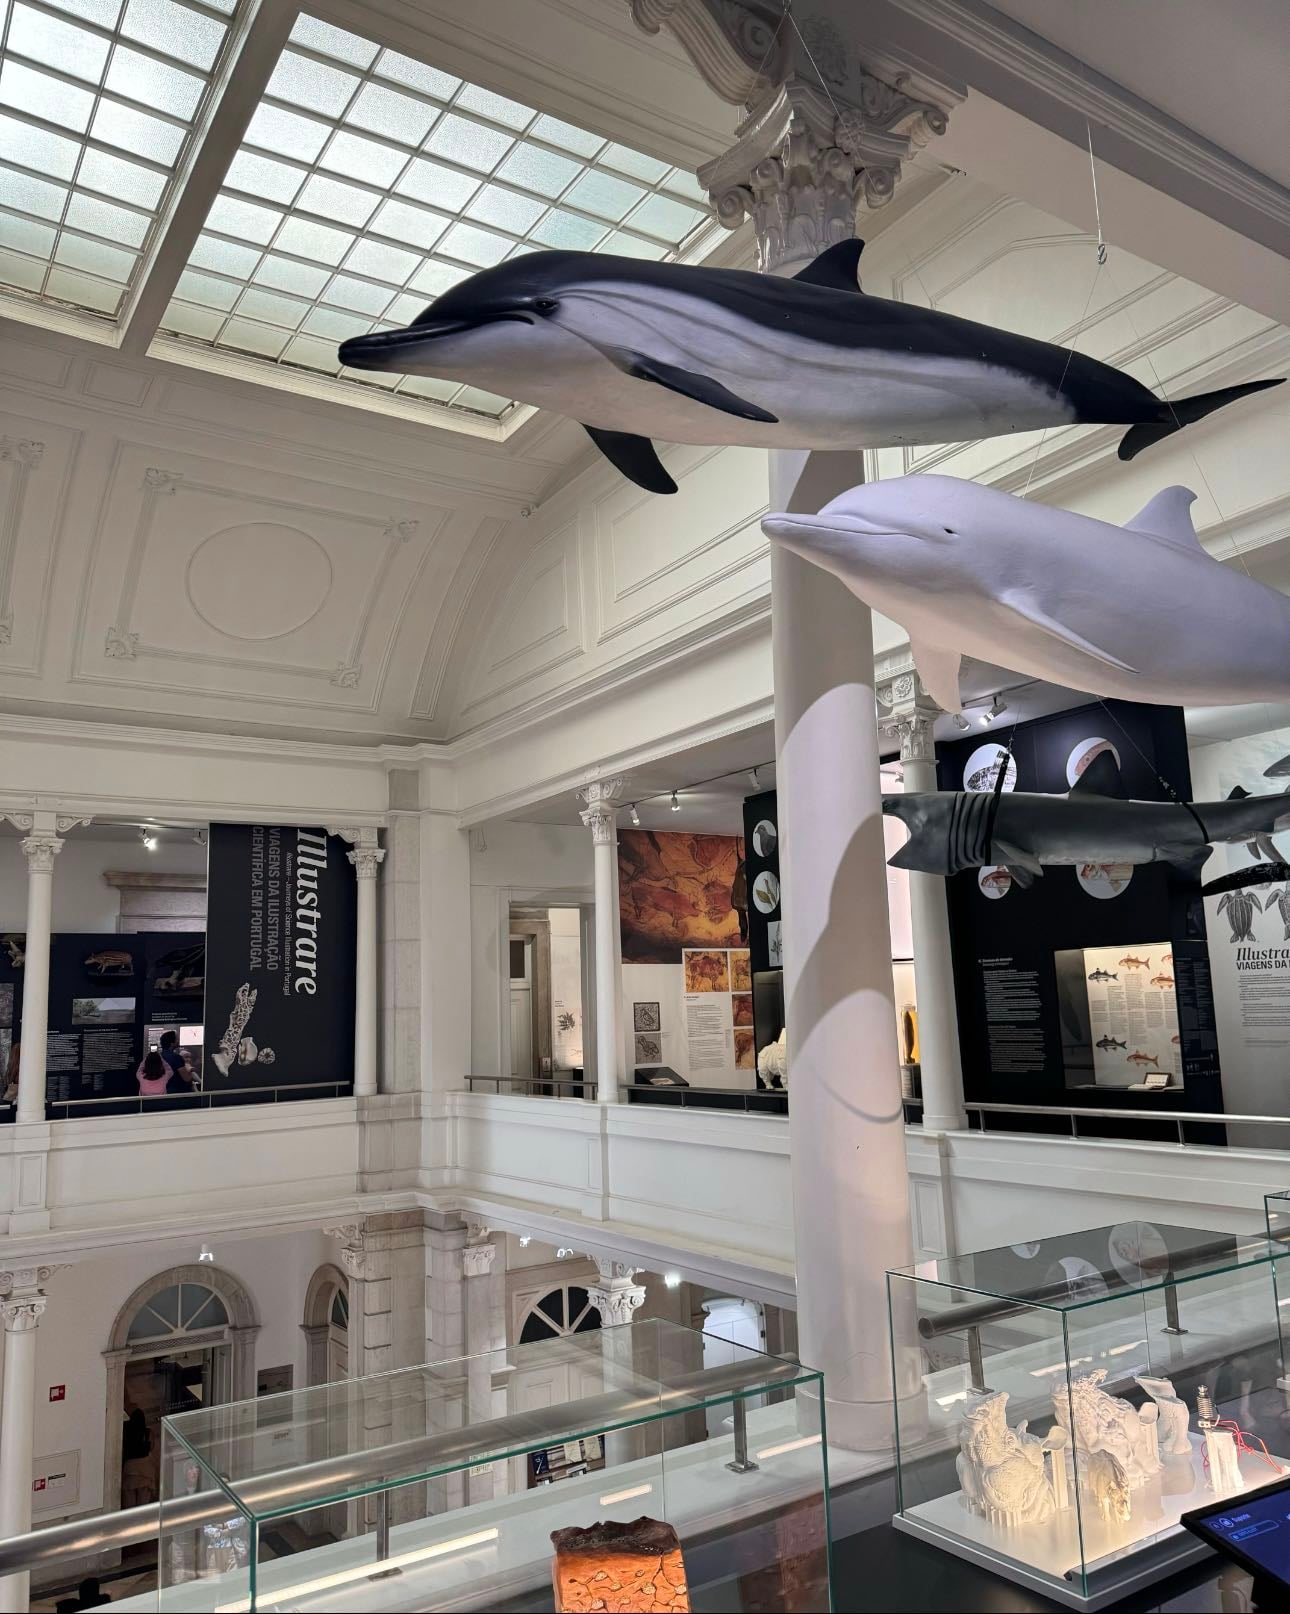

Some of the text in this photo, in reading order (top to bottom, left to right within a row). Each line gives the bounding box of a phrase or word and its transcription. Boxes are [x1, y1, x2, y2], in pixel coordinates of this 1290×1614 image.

[249, 826, 267, 971] CIENTÍFICA EM PORTUGAL
[264, 828, 282, 970] VIAGENS DA ILUSTRAÇÃO
[285, 914, 293, 935] Science
[294, 828, 328, 995] Illustrare
[283, 973, 292, 996] Portugal
[1236, 960, 1273, 970] VIAGENS
[1275, 959, 1288, 969] DA
